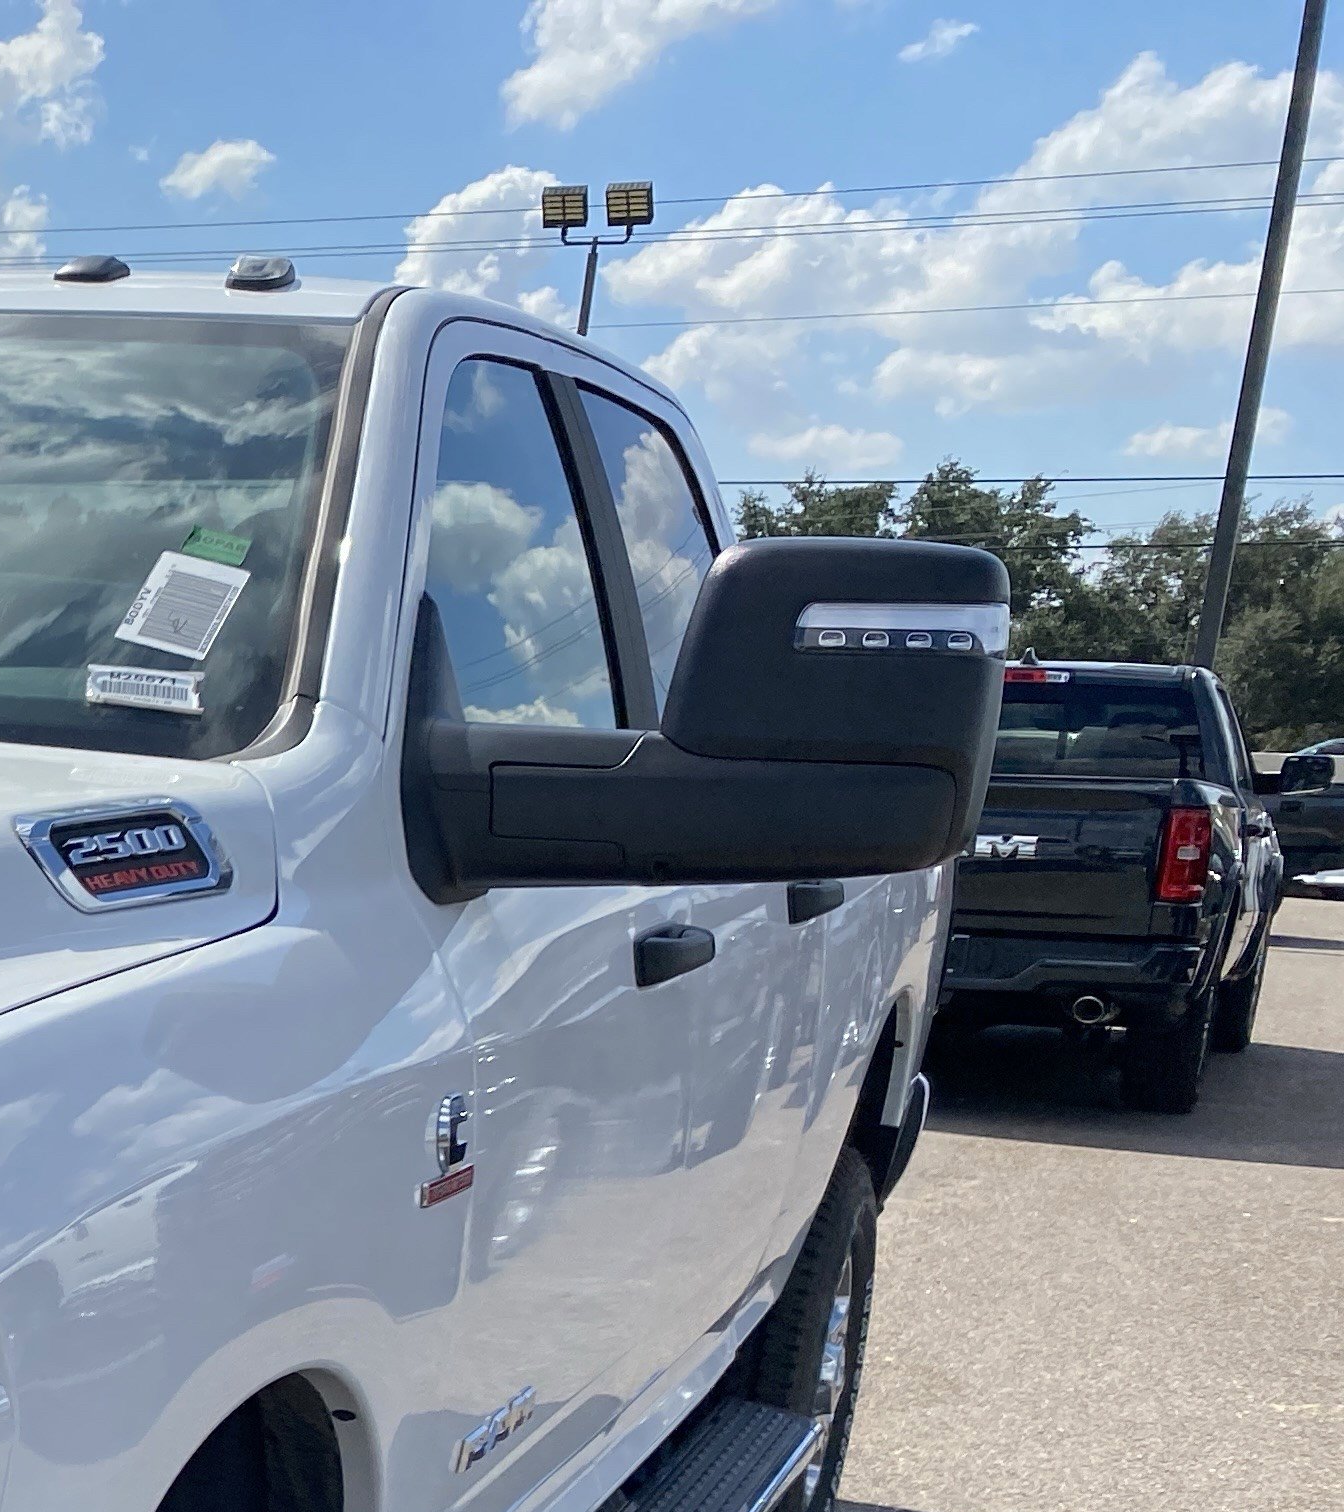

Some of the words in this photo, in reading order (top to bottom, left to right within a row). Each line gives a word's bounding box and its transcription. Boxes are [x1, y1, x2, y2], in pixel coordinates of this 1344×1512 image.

[63, 823, 188, 866] 2500
[85, 865, 153, 892] HEAVY
[154, 860, 200, 881] DUTY
